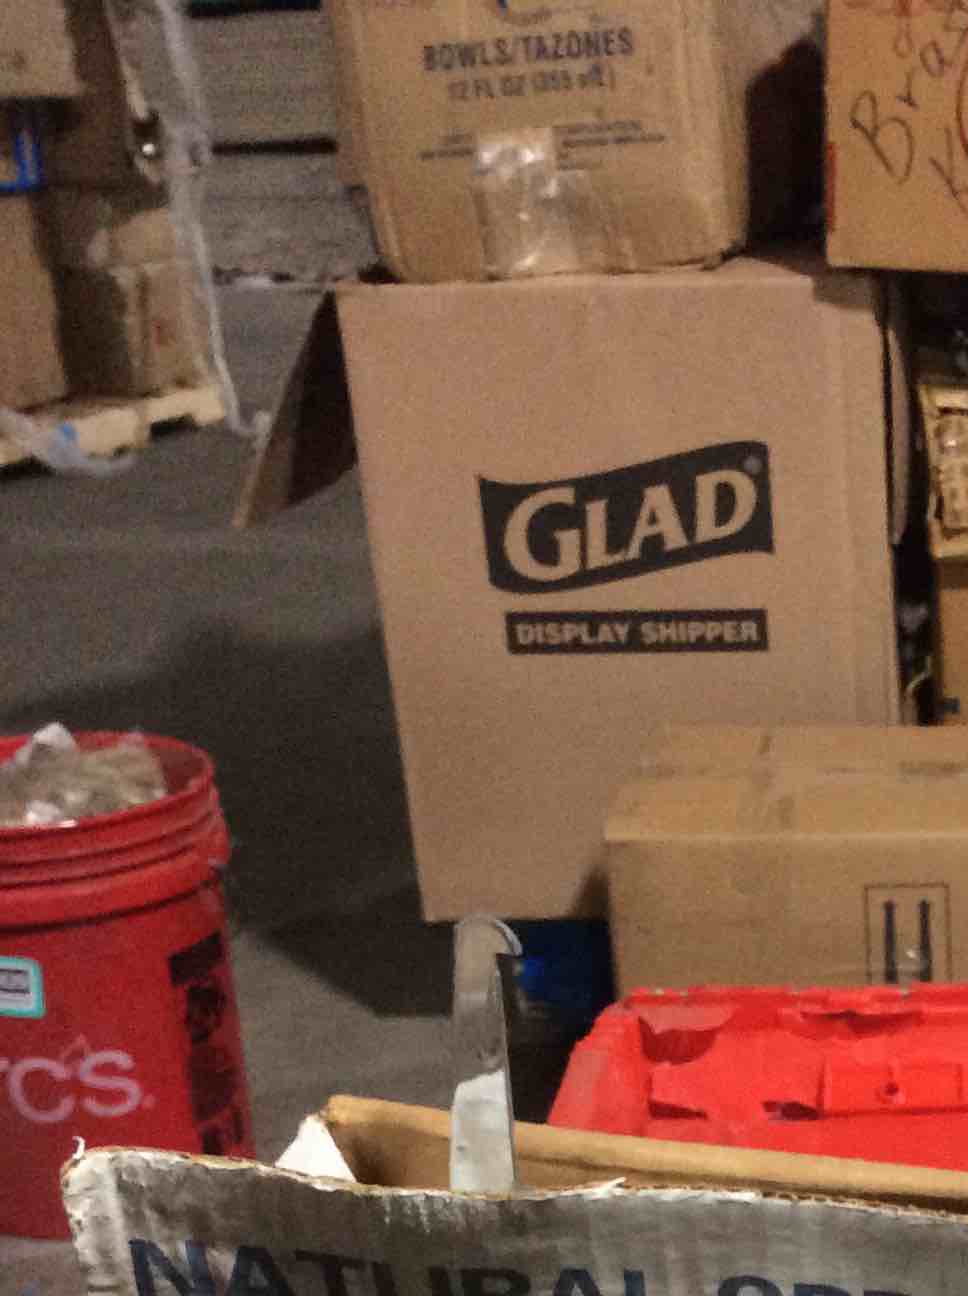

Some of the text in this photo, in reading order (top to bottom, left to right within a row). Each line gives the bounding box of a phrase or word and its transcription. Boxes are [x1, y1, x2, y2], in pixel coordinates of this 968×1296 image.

[503, 467, 758, 583] GLAD
[514, 619, 758, 645] DISPLAY SHIPPER
